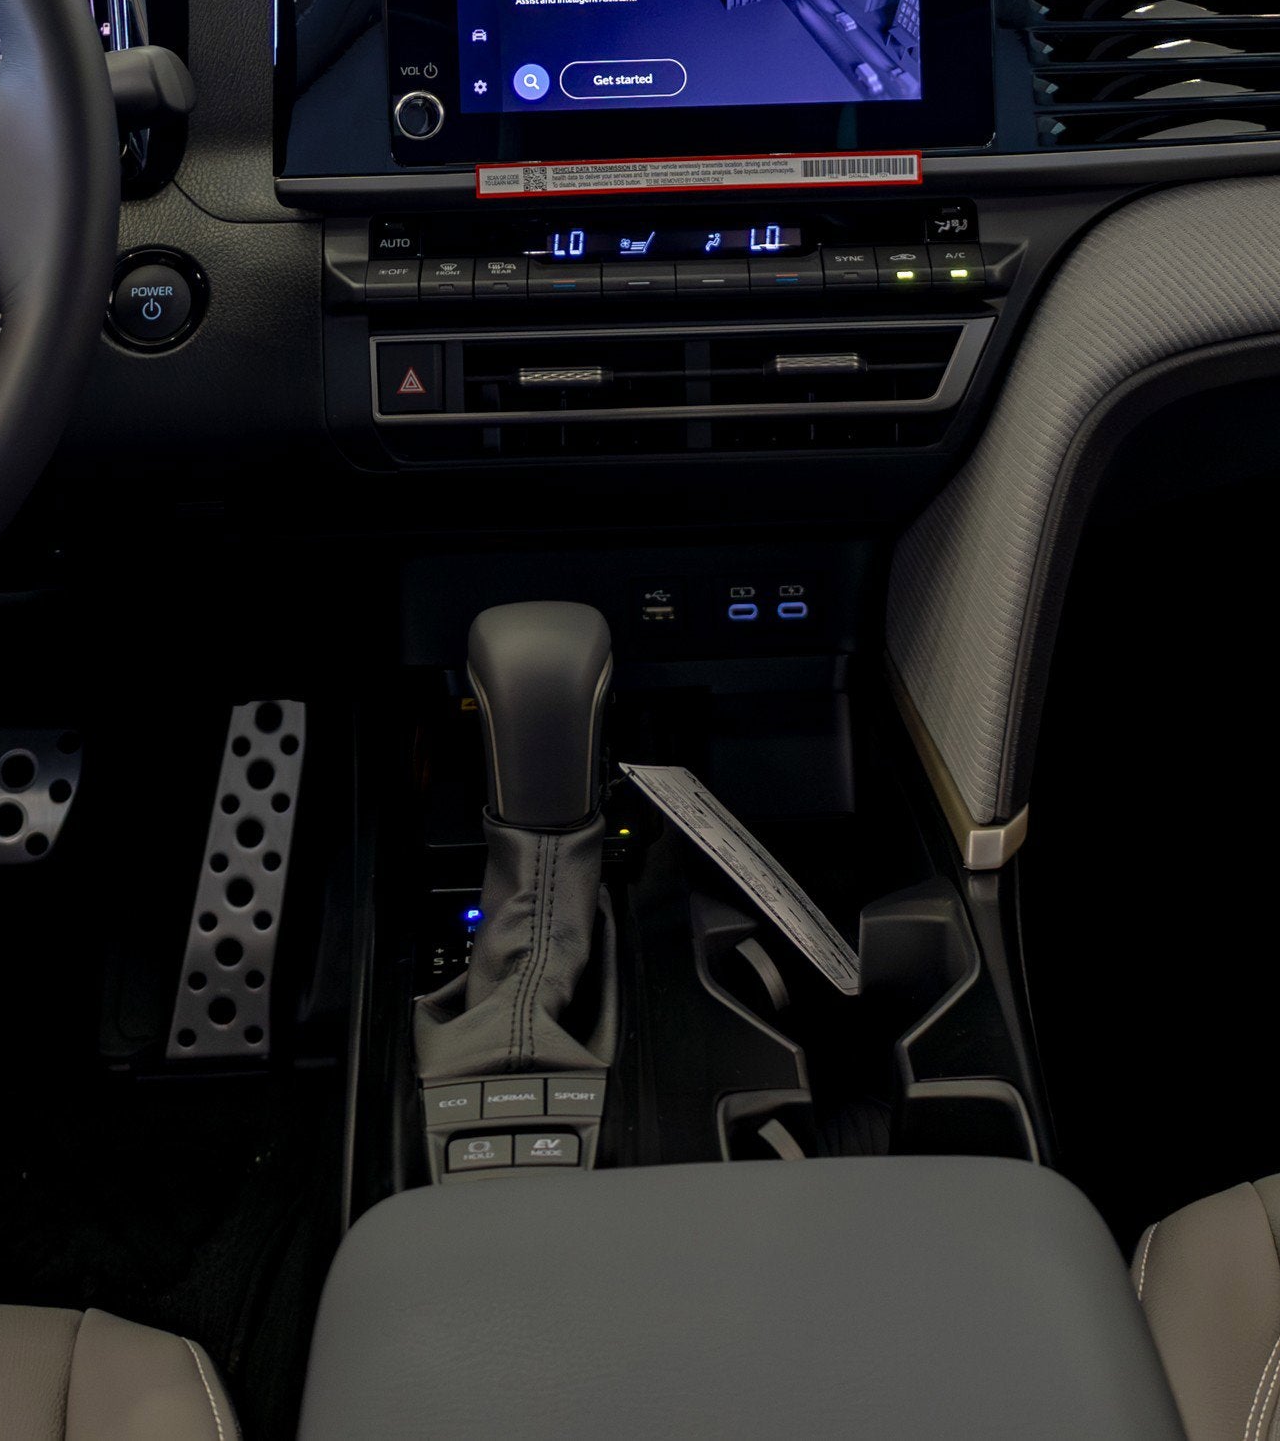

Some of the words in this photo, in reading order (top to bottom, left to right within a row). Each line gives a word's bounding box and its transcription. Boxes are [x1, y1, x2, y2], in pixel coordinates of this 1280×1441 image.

[400, 66, 421, 76] VOL
[593, 74, 614, 86] Get
[616, 73, 653, 85] started
[591, 164, 630, 173] TRANSMISSION
[380, 238, 410, 249] AUTO
[553, 229, 584, 257] LO
[751, 225, 780, 251] LO
[945, 251, 966, 260] A/C
[131, 286, 173, 298] POWER
[467, 909, 479, 919] P
[433, 957, 445, 966] S
[439, 1098, 468, 1108] ECO
[487, 1092, 536, 1103] NORMAL
[554, 1092, 596, 1101] SPORT
[532, 1138, 561, 1149] EV
[463, 1152, 494, 1160] HOLD
